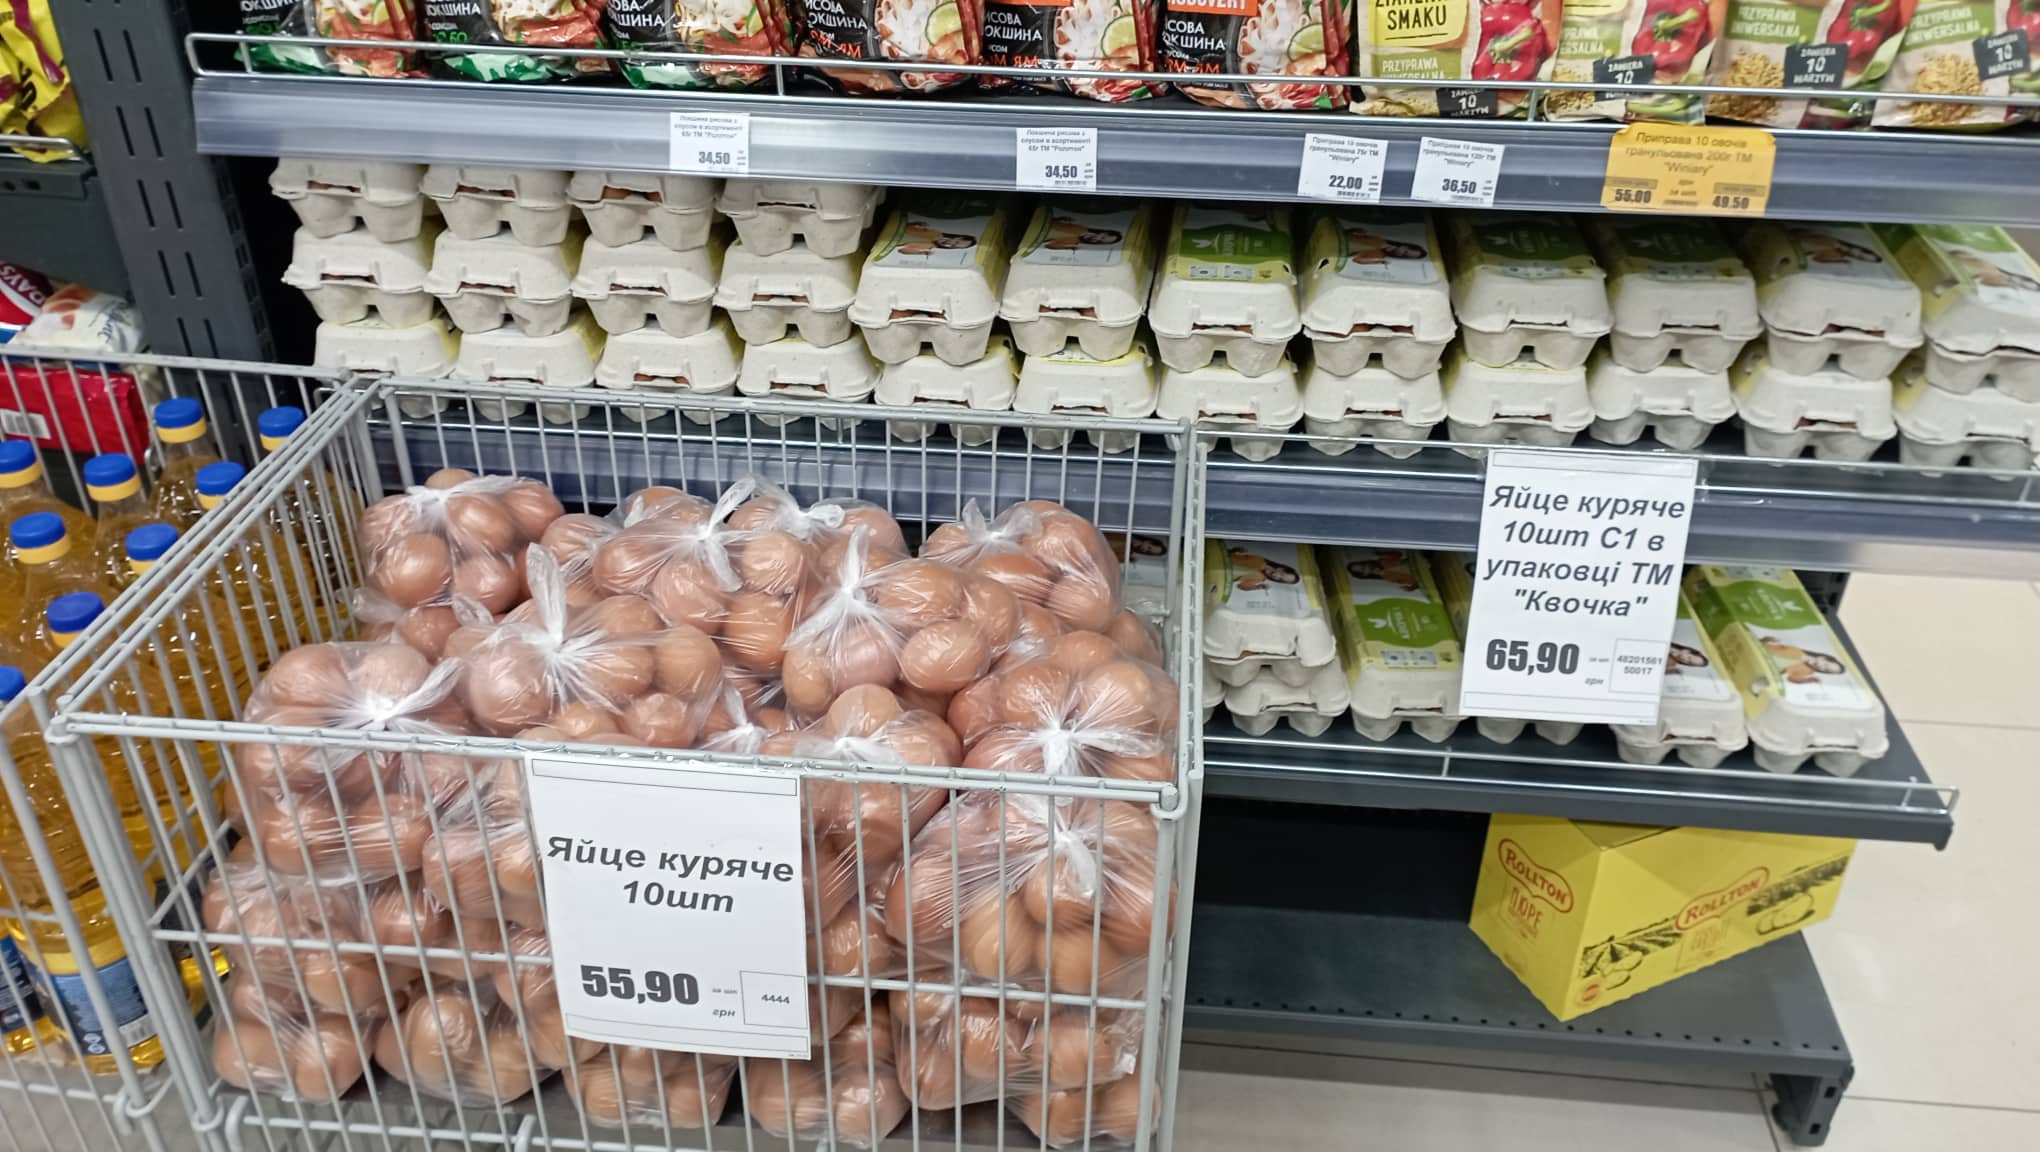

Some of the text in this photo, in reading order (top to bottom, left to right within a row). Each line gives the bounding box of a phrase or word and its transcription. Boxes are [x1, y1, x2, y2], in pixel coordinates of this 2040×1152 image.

[1387, 5, 1446, 30] SMAKU
[1996, 43, 2012, 62] 10
[1382, 57, 1438, 72] PRZYPRAWA
[1807, 57, 1826, 73] 10
[1615, 70, 1634, 84] 10
[1459, 95, 1477, 110] 10
[1636, 132, 1691, 145] Приправа
[1695, 136, 1709, 146] 10
[698, 151, 730, 165] 34,50
[1736, 152, 1753, 162] ТМ
[1045, 165, 1077, 179] 34,50
[1328, 175, 1363, 189] 22,00
[1442, 179, 1477, 193] 36,50
[1490, 485, 1685, 520] Яйце куряче
[1503, 521, 1589, 548] 10шт
[1648, 534, 1665, 551] в
[1483, 559, 1674, 587] упаковці ТМ
[1514, 588, 1648, 616] "Квочка"
[1486, 638, 1580, 675] 65,90
[547, 836, 794, 882] Яйце куряче
[1506, 848, 1567, 904] ROLLTON
[623, 880, 734, 912] 10шт
[1684, 877, 1760, 924] ROLLTON
[580, 964, 699, 1005] 55,90
[761, 994, 790, 1004] 4444
[712, 1008, 736, 1018] грн
